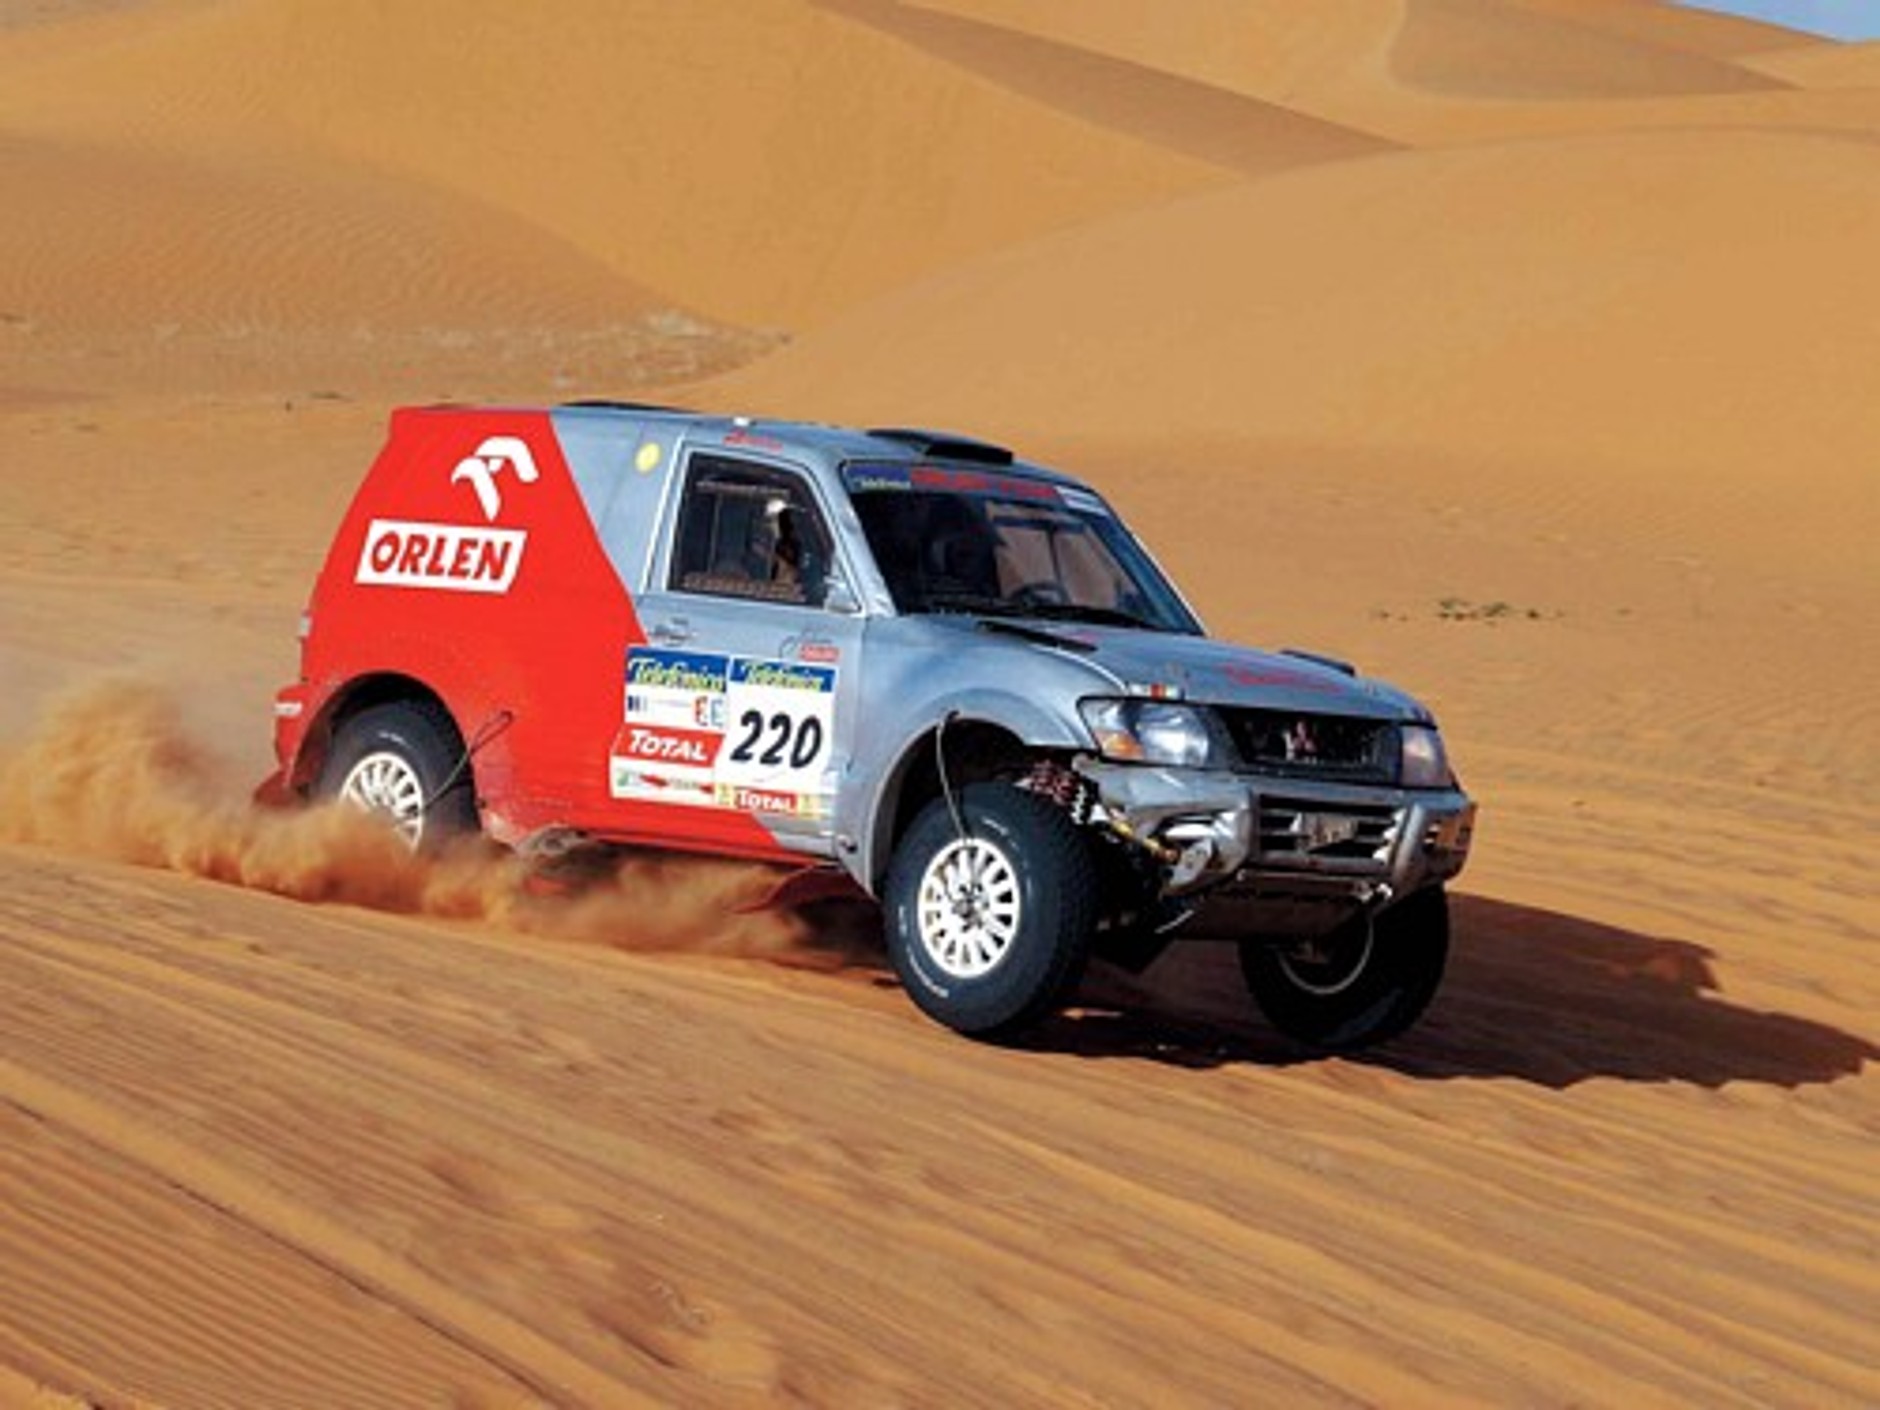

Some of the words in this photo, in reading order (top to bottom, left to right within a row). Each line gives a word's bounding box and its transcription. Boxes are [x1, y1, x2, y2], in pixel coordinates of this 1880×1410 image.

[371, 530, 512, 580] ORLEN
[628, 729, 708, 761] TOTAL
[729, 709, 822, 768] 220
[737, 789, 797, 812] TOTAL
